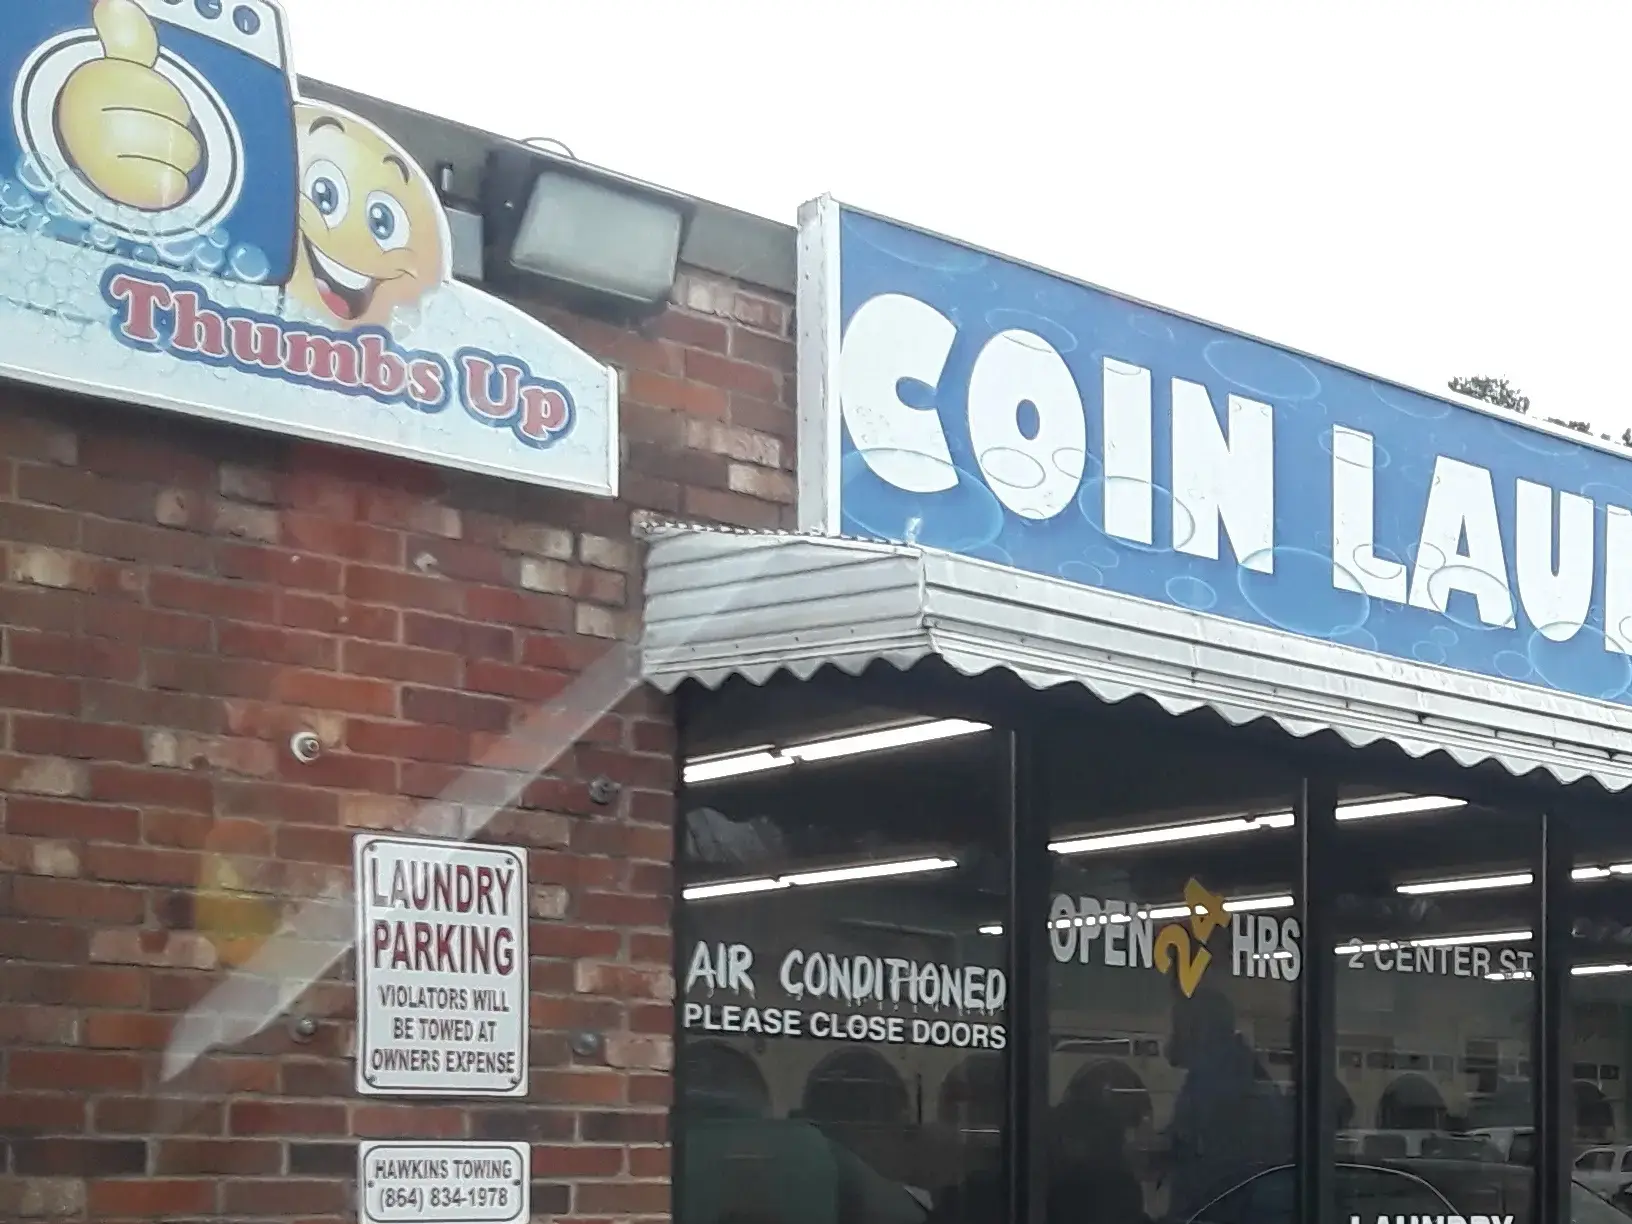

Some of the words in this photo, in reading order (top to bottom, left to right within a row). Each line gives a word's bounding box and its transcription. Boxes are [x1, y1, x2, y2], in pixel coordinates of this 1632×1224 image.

[107, 271, 446, 408] Thumbs
[458, 352, 569, 440] Up
[839, 292, 1274, 575] COIN
[371, 857, 514, 917] LAUNDRY
[373, 918, 515, 977] PARKING
[1050, 893, 1153, 969] OPEN
[1154, 877, 1233, 999] 24
[1232, 913, 1301, 982] HRS
[1374, 939, 1491, 977] CENTER
[378, 984, 469, 1010] VIOLATORS
[472, 988, 510, 1012] WILL
[686, 940, 755, 997] AIR
[780, 948, 1006, 1012] CONDITIONED
[393, 1016, 414, 1040] BE
[418, 1017, 474, 1041] TOWED
[477, 1020, 497, 1042] AT
[683, 1002, 802, 1036] PLEASE
[810, 1011, 904, 1042] CLOSE
[912, 1018, 1006, 1049] DOORS
[371, 1048, 441, 1072] OWNERS
[445, 1050, 516, 1074] EXPENSE
[374, 1159, 449, 1179] HAWKINS
[452, 1159, 513, 1179] TOWING
[379, 1187, 424, 1213] (864)
[429, 1186, 509, 1207] 834-1978
